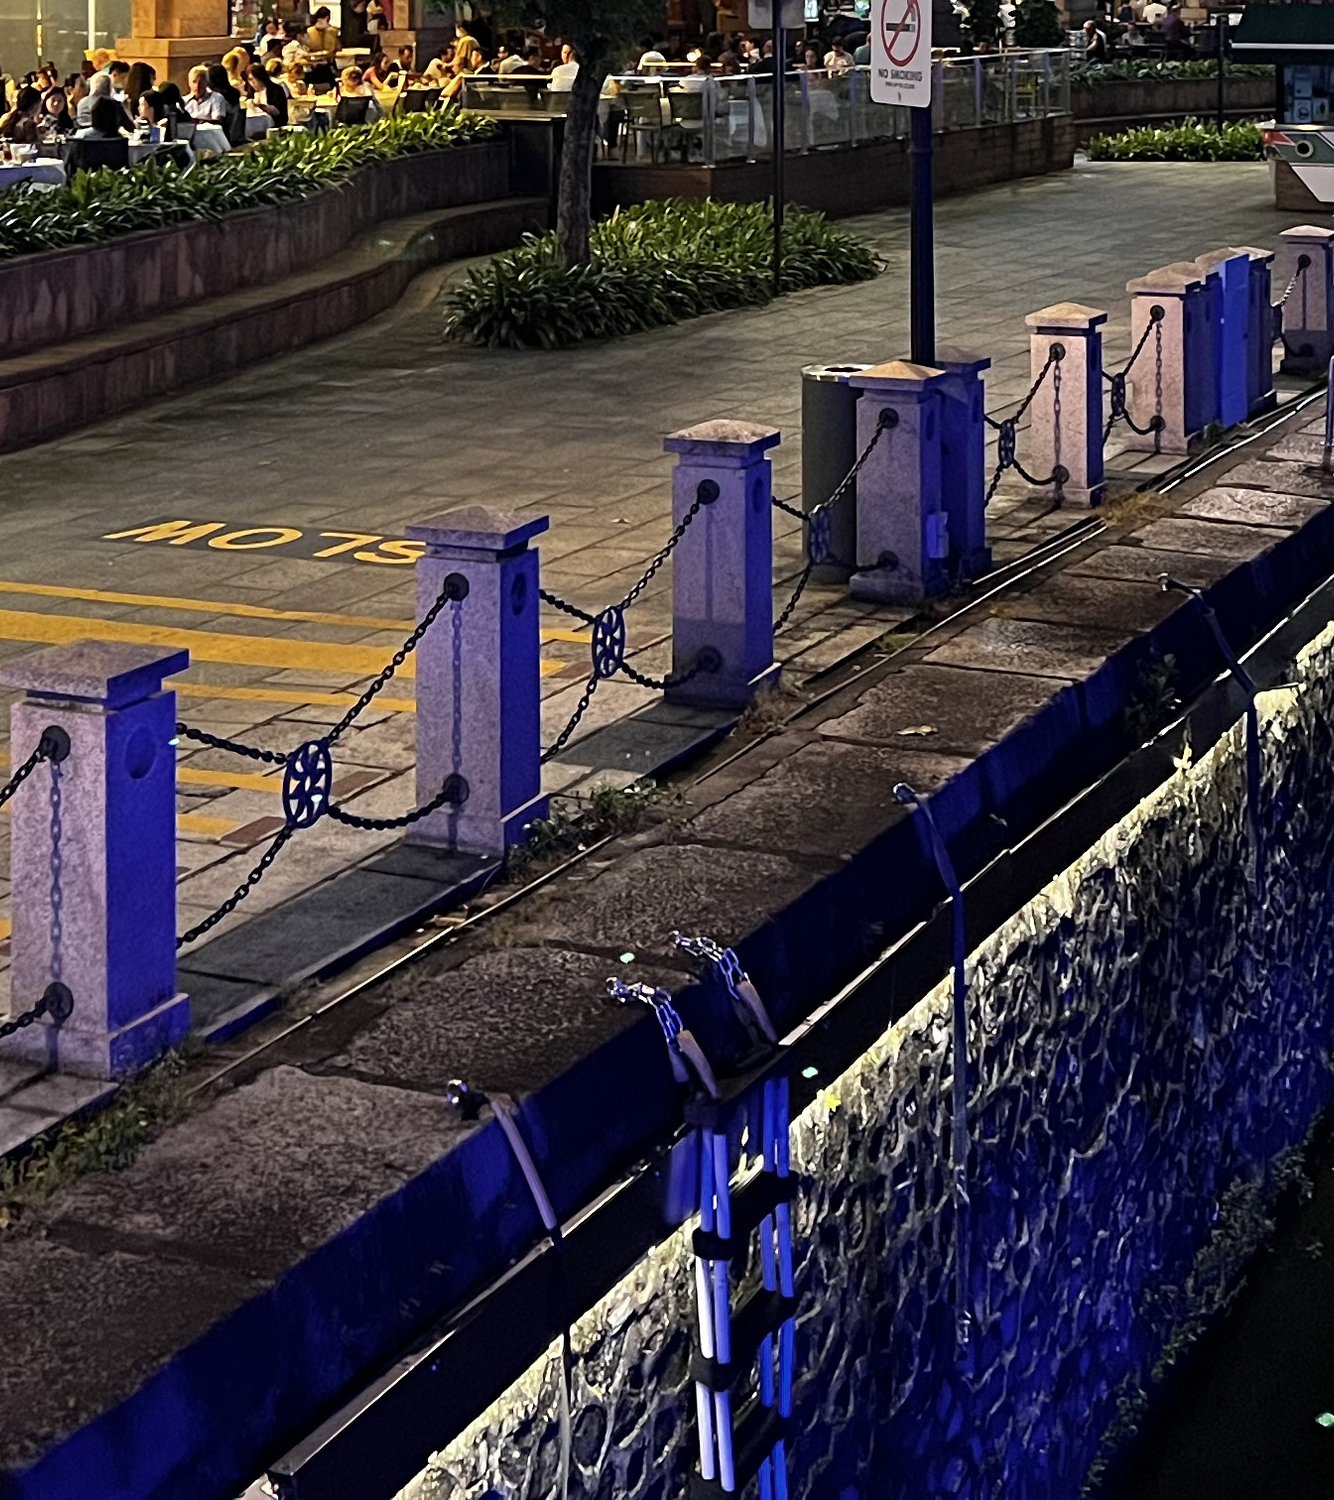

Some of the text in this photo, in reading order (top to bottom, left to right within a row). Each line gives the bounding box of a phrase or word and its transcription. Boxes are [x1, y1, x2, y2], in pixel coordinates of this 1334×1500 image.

[878, 68, 923, 81] NO SMOKING
[101, 519, 427, 565] SLOW
